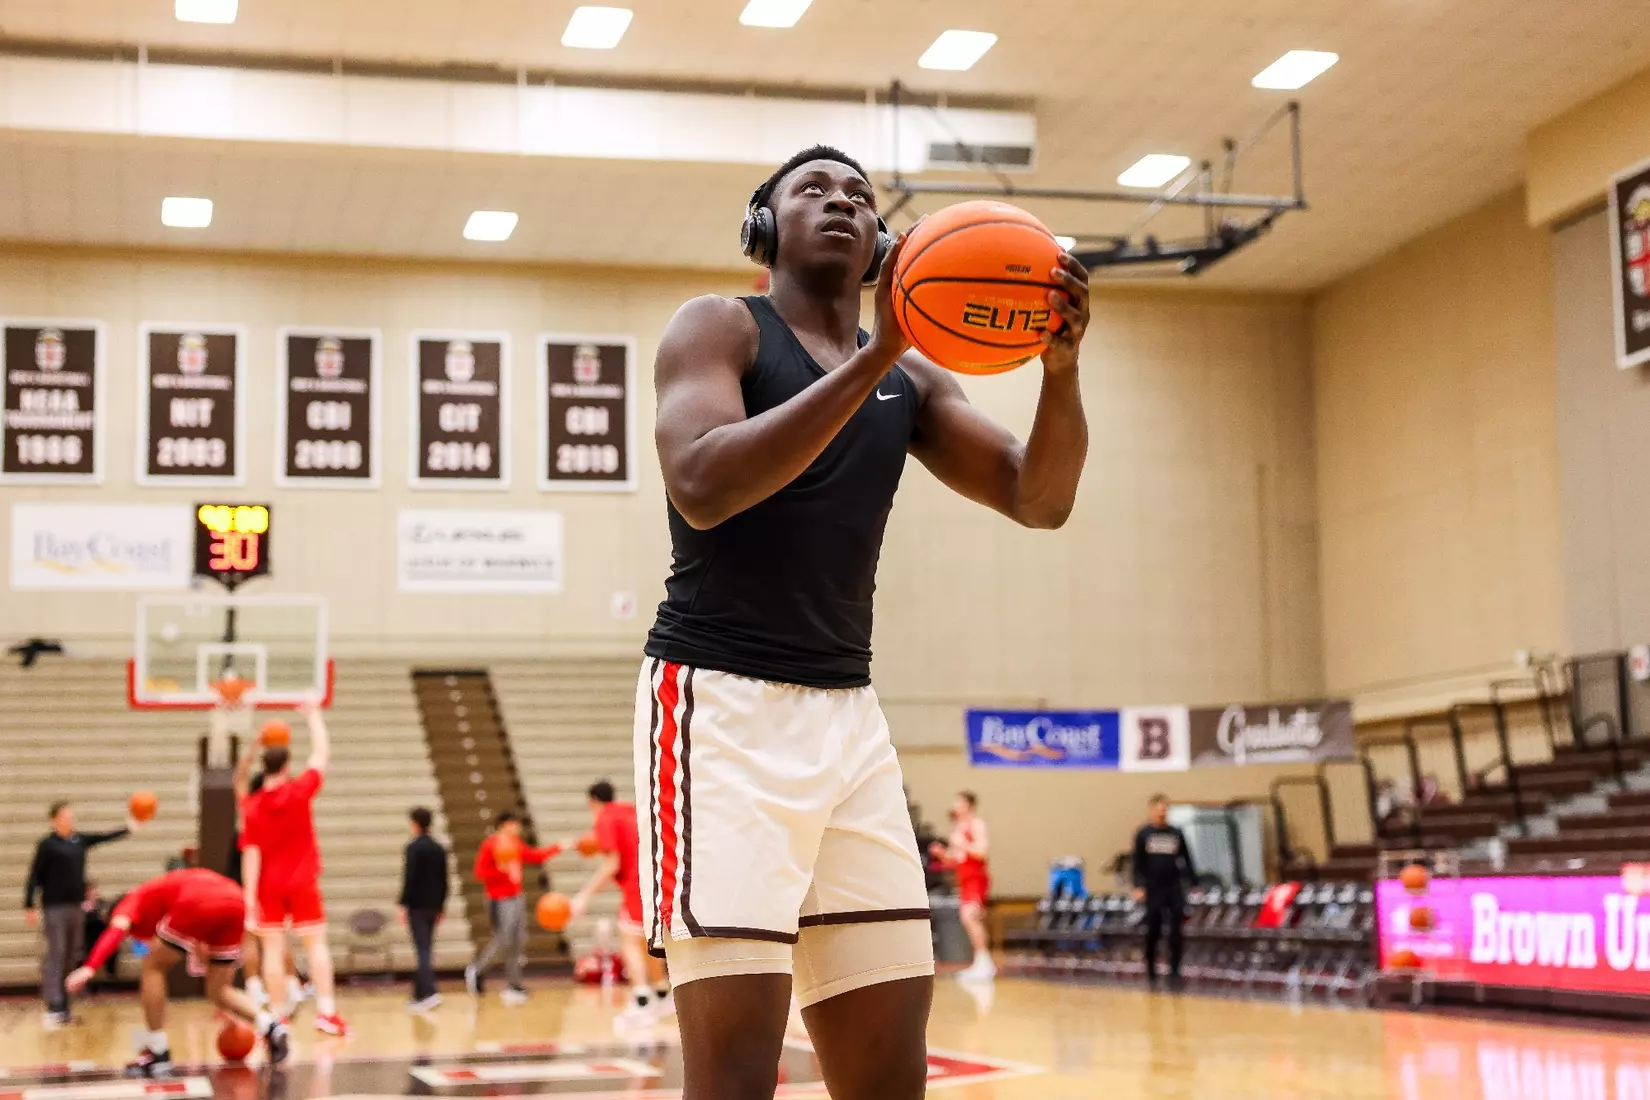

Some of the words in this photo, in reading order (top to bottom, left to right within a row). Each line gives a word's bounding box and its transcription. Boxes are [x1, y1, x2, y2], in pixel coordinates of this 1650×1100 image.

[962, 302, 1051, 332] ELITE
[170, 397, 214, 427] NIT
[306, 401, 351, 430] CBI
[439, 403, 482, 432] CIT
[565, 406, 609, 435] CBI
[427, 441, 491, 471] 2014
[208, 529, 259, 571] 30
[1139, 718, 1170, 760] B
[1471, 893, 1597, 969] Brown
